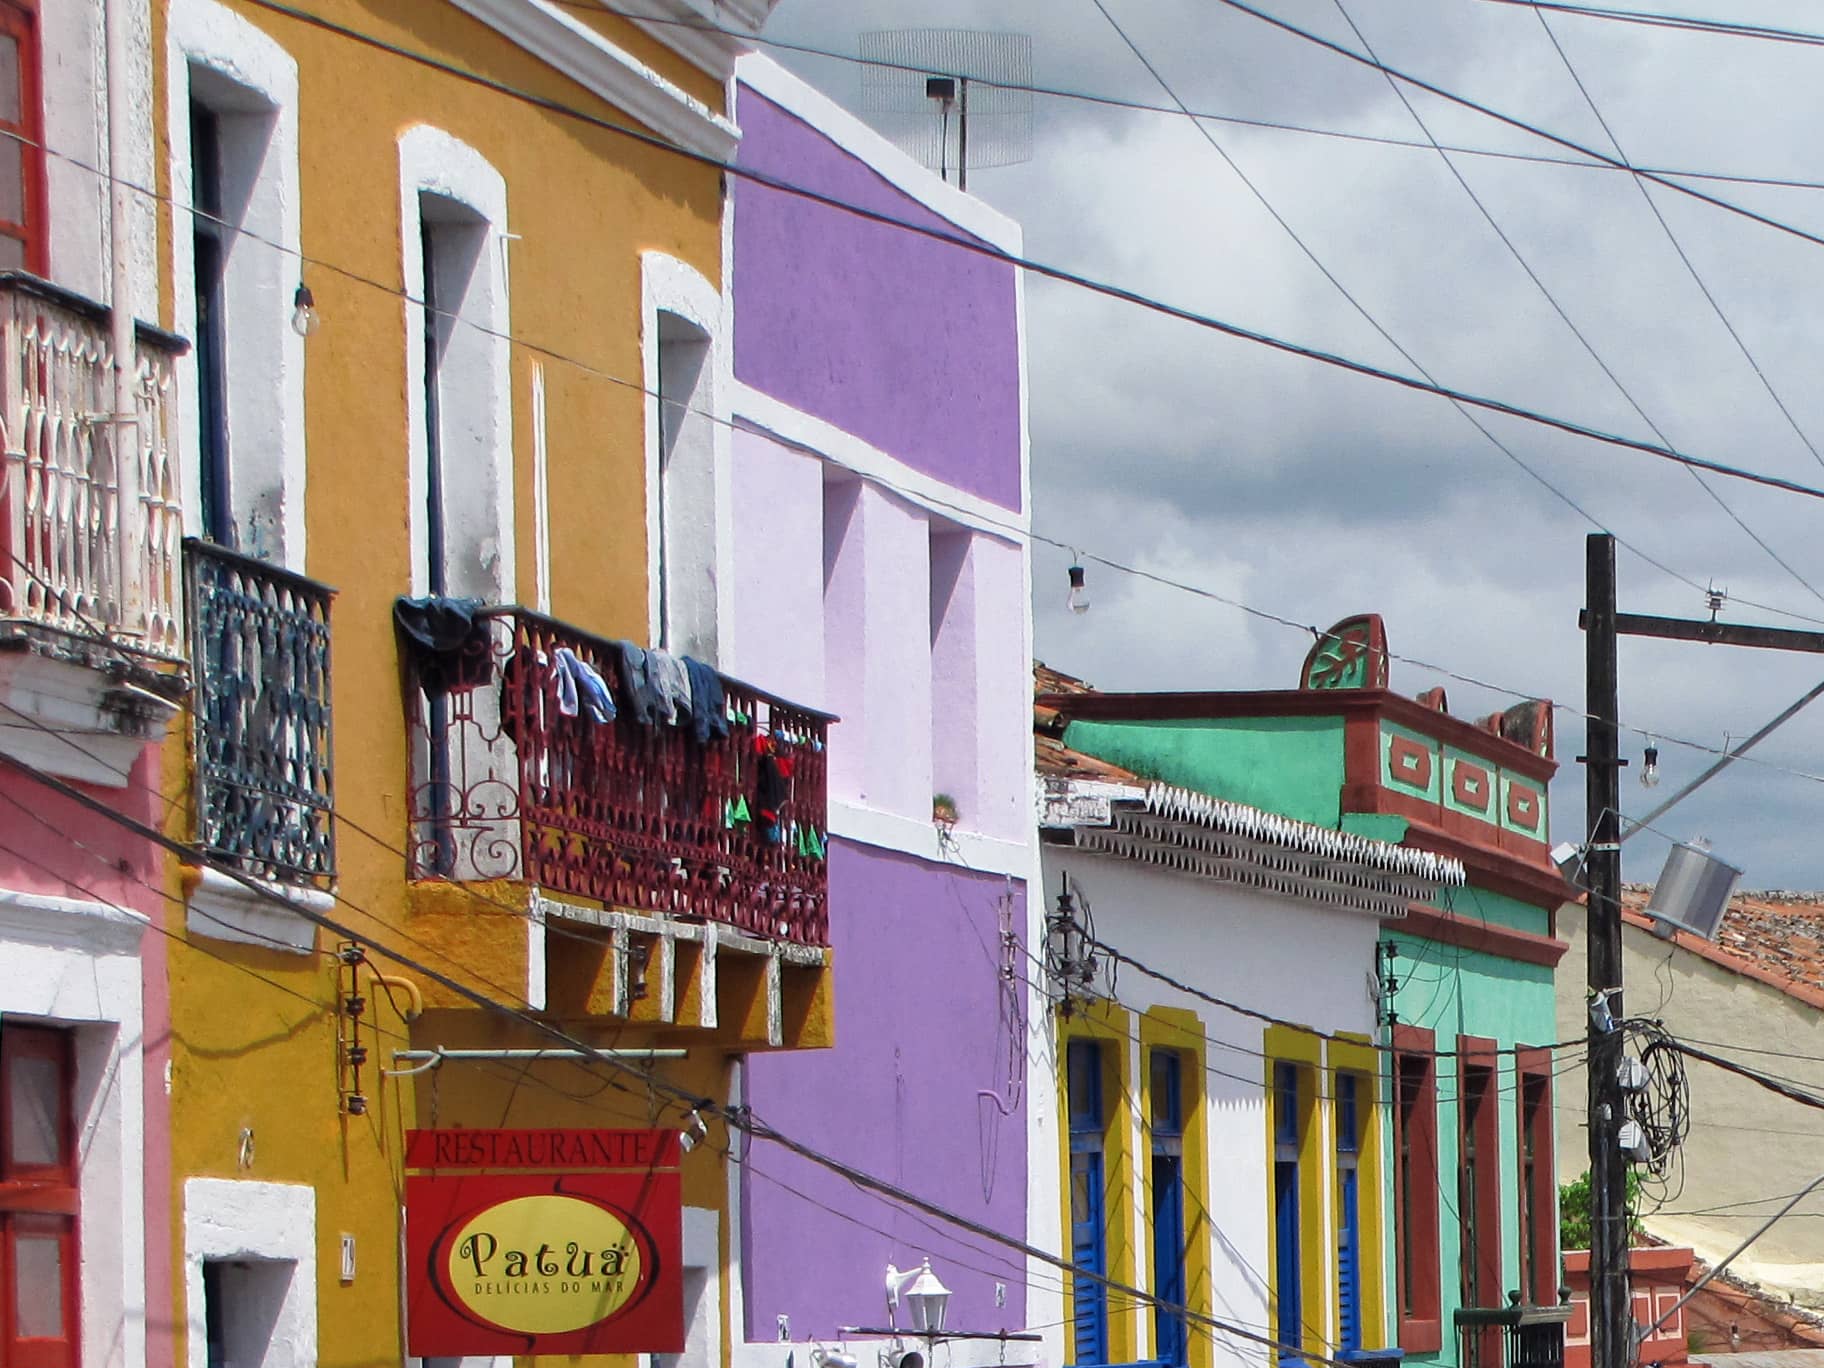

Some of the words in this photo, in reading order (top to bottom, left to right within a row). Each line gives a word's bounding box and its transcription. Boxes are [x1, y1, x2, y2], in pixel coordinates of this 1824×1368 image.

[435, 1133, 650, 1163] RESTAURANTE
[474, 1280, 551, 1294] DELÍCIAS
[561, 1281, 581, 1293] DO
[591, 1281, 624, 1293] MAR
